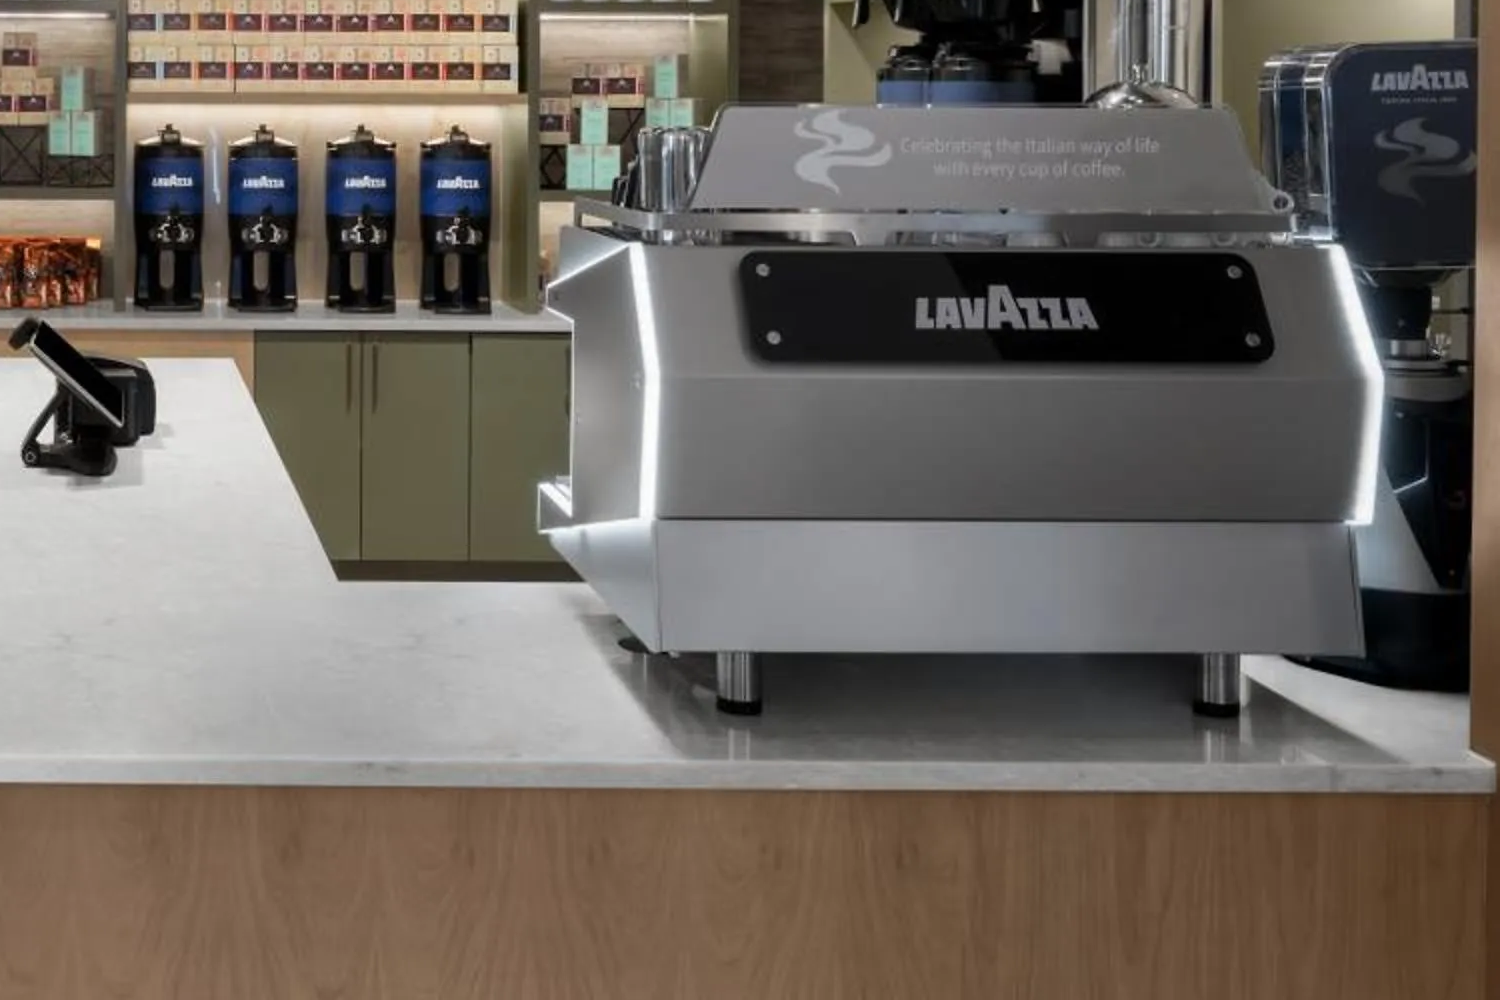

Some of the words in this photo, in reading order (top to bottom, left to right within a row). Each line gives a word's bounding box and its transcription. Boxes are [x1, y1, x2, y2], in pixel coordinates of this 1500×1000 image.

[1371, 64, 1469, 91] LAVAZZA
[902, 137, 992, 158] Celebrating
[995, 138, 1021, 154] the
[1025, 138, 1075, 154] Italian
[1079, 141, 1111, 157] way
[1114, 137, 1132, 154] of
[1134, 137, 1160, 154] life
[933, 160, 969, 176] with
[972, 163, 1014, 179] every
[1018, 163, 1049, 179] cup
[1052, 160, 1069, 177] of
[1071, 160, 1125, 177] coffee.
[915, 284, 1099, 329] LAVAZZA
